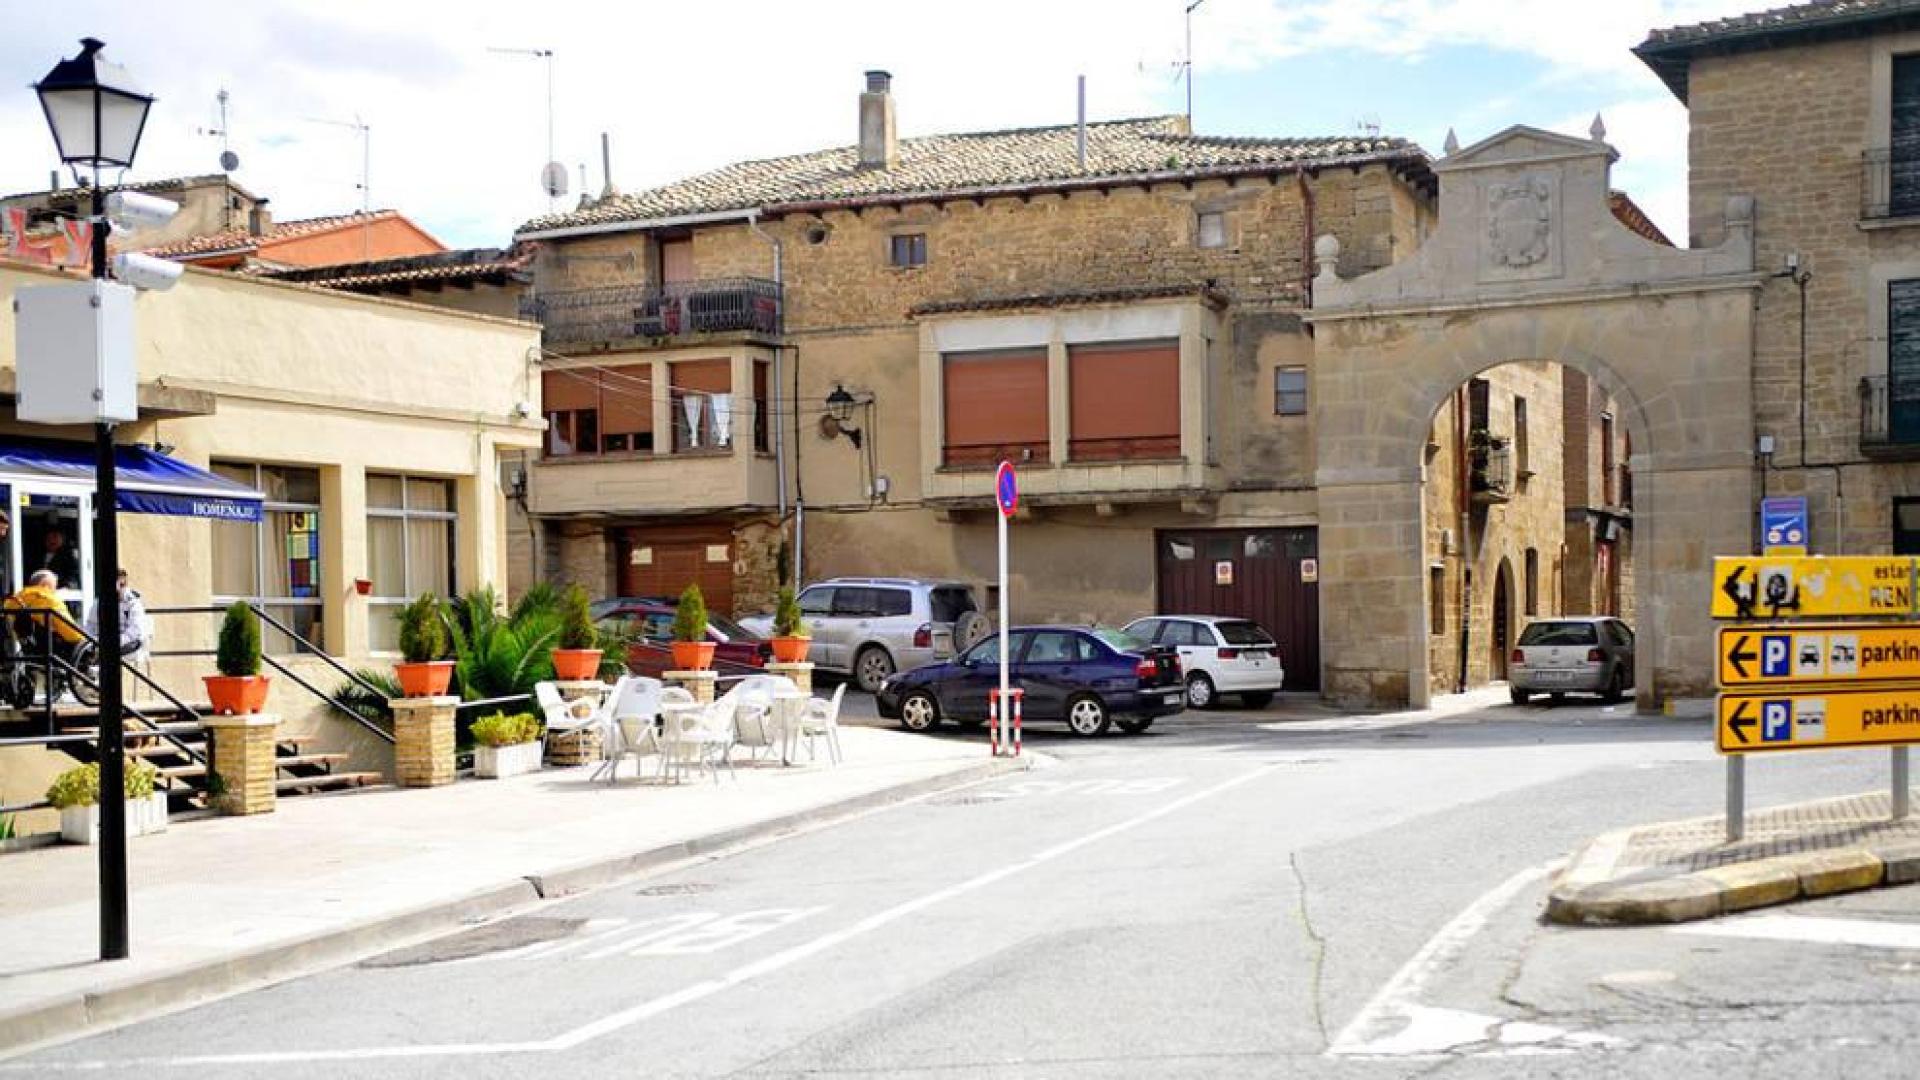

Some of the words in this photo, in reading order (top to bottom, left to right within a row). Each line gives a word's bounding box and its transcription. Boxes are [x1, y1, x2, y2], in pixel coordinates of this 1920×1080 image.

[193, 501, 257, 519] HOMENAJE
[1870, 586, 1911, 607] REN
[1766, 639, 1786, 673] P
[1861, 639, 1920, 668] parkin
[1766, 704, 1786, 738] P
[1861, 702, 1920, 731] parkin
